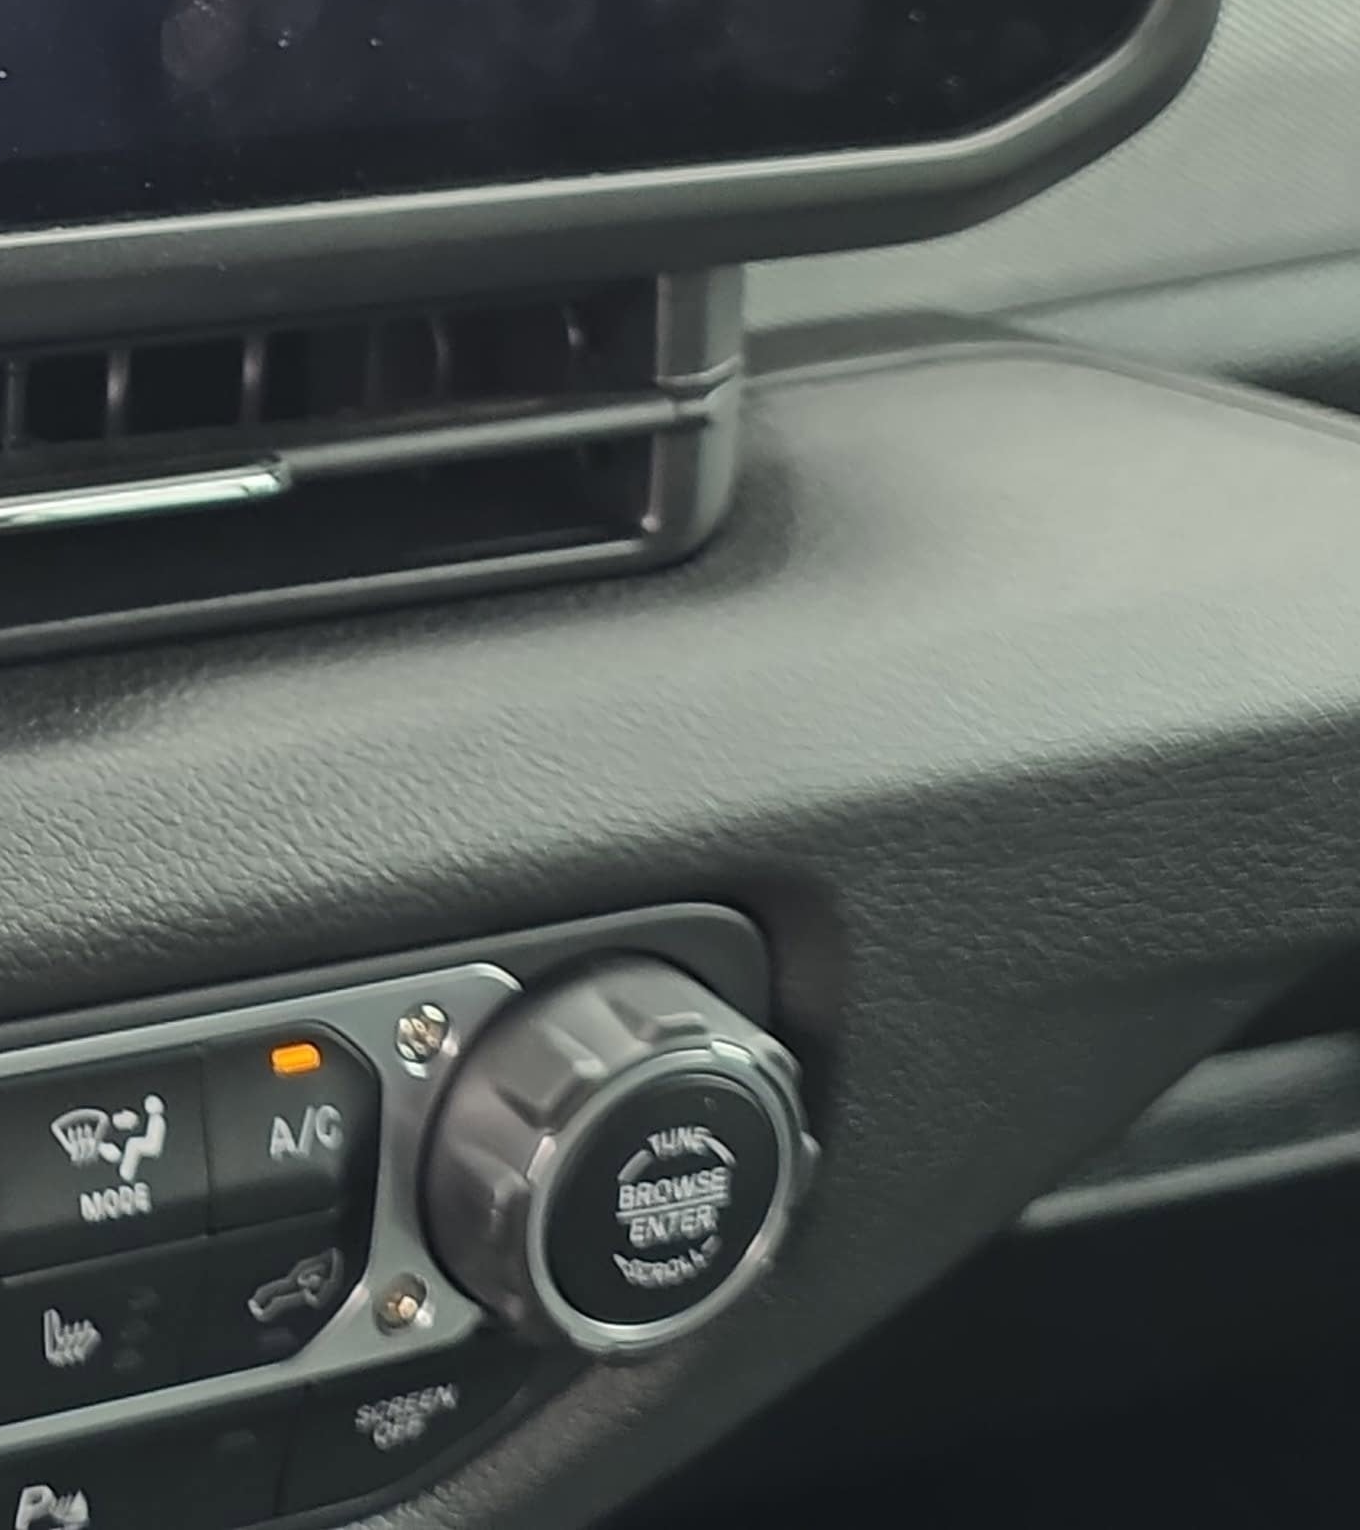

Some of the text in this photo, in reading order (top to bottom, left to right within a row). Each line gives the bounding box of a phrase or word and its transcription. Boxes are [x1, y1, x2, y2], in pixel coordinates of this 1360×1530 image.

[268, 1104, 344, 1160] A/C
[80, 1181, 152, 1223] MODE
[618, 1166, 729, 1212] BROWSE
[629, 1205, 718, 1247] ENTER
